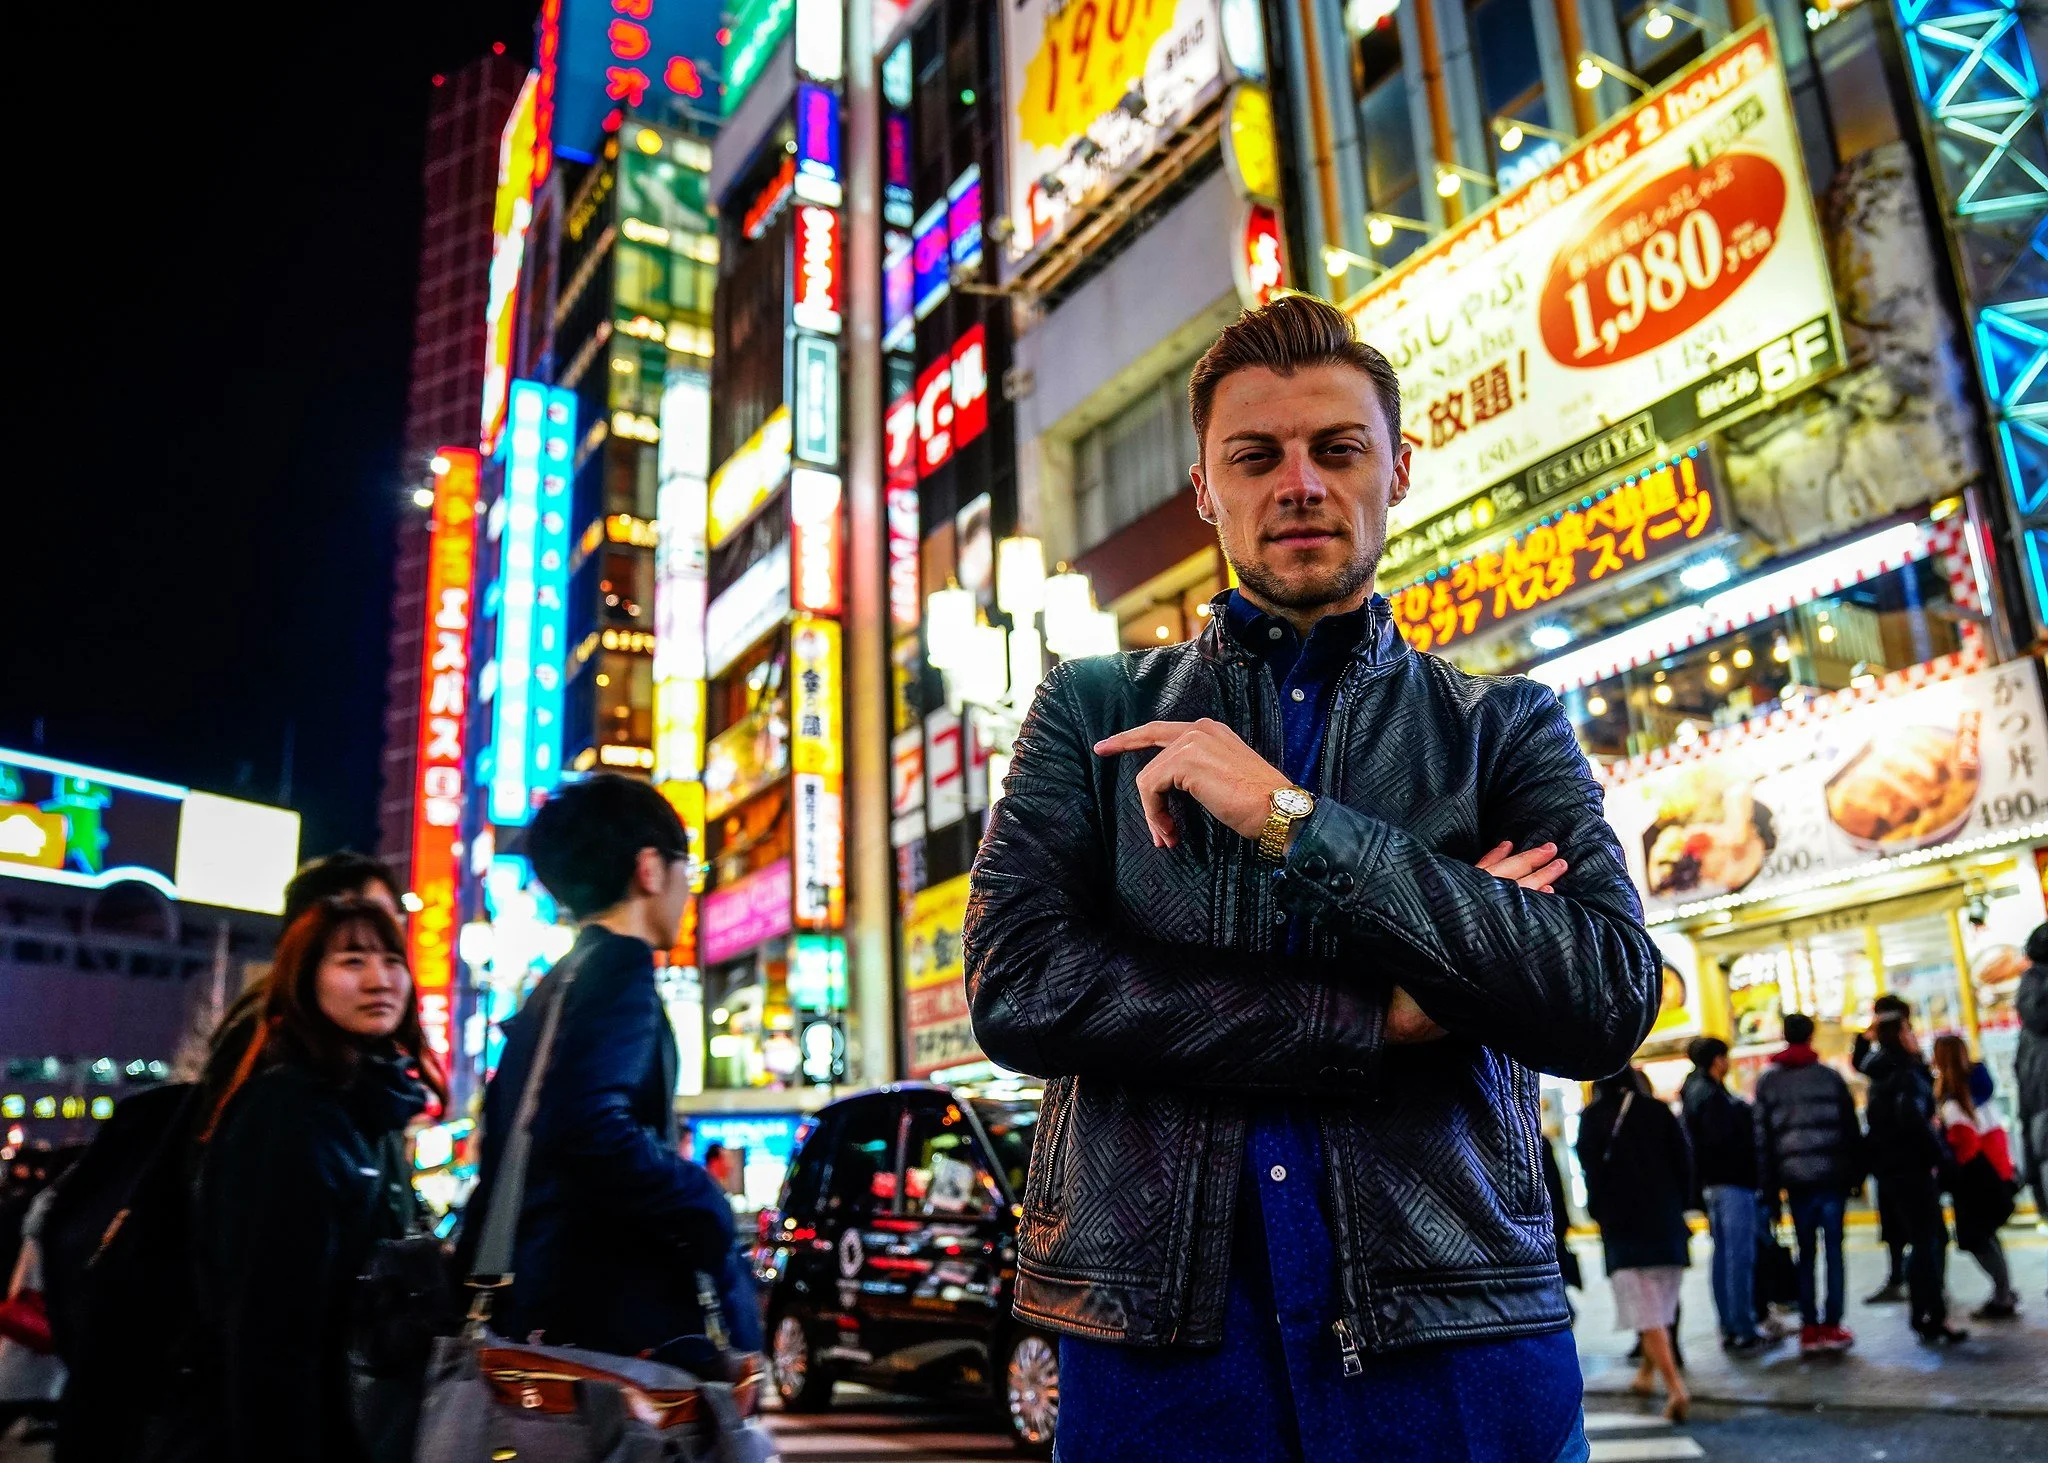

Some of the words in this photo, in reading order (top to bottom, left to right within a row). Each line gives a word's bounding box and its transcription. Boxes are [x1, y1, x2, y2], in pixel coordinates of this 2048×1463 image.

[1496, 161, 1580, 238] buffet
[1583, 129, 1631, 179] for
[1634, 105, 1663, 147] 2
[1663, 43, 1764, 126] hours
[1565, 208, 1723, 359] 1,980
[1756, 319, 1829, 394] 5F
[1588, 490, 1712, 580] スイーツ
